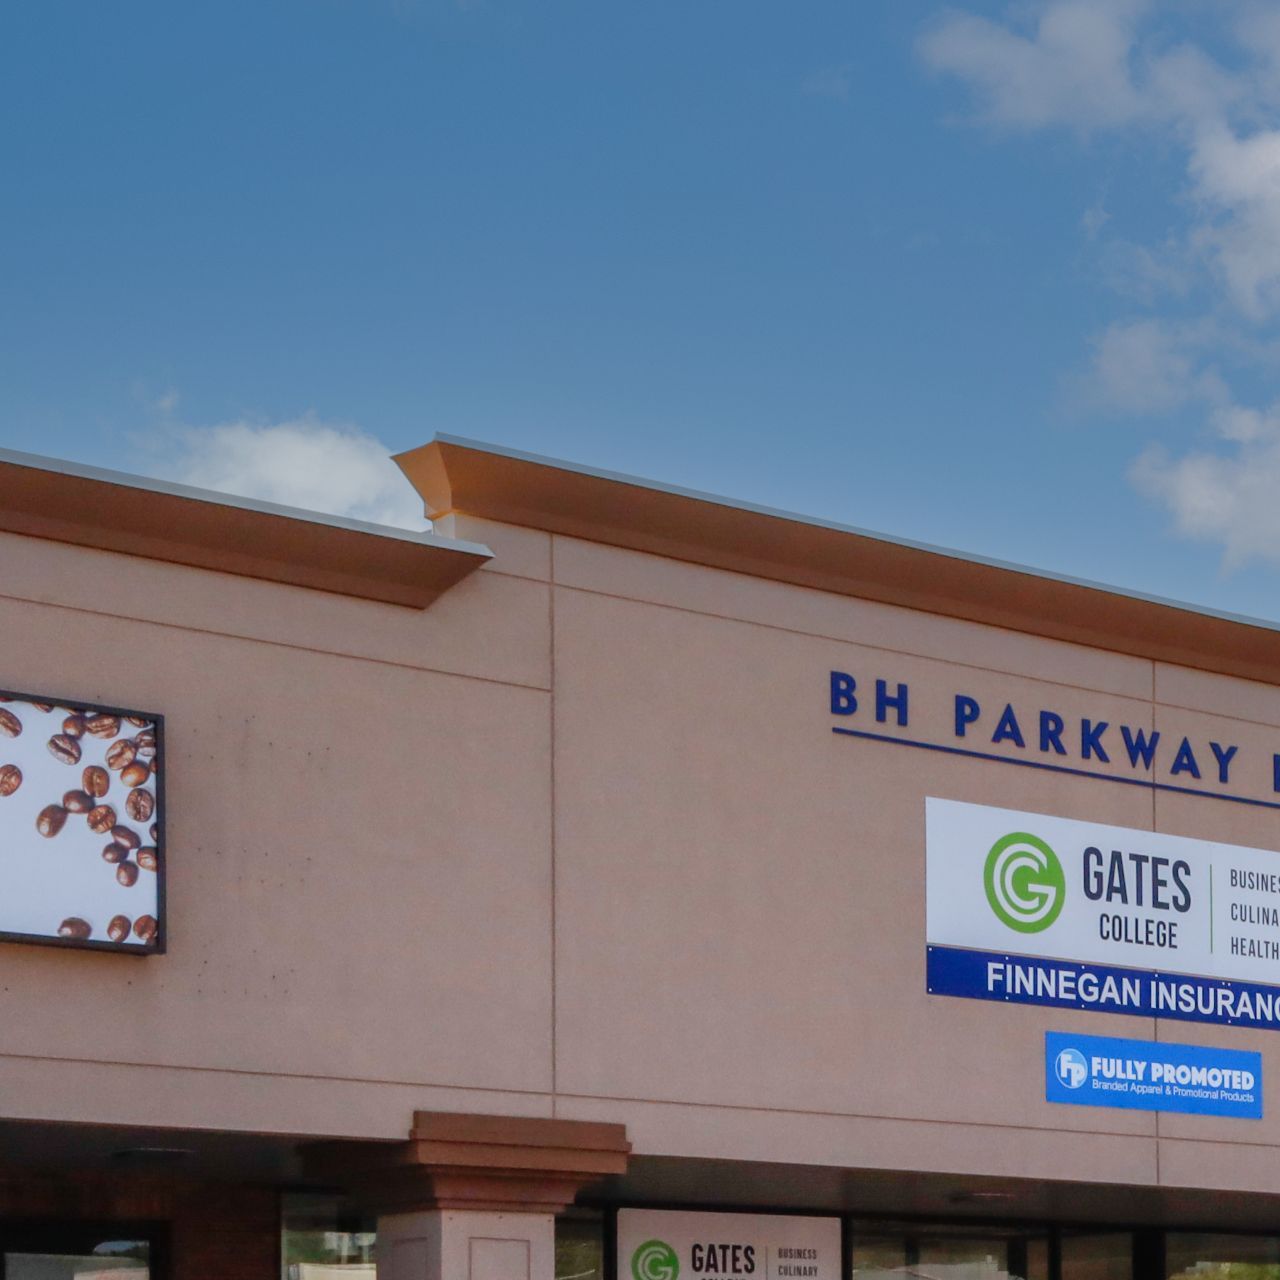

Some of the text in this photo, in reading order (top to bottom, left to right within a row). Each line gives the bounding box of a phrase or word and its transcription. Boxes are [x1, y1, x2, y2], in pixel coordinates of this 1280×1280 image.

[830, 671, 909, 726] BH
[953, 695, 1238, 784] PARKWAY
[1082, 845, 1192, 913] GATES
[1099, 913, 1178, 949] COLLEGE
[986, 961, 1142, 1007] FINNEGAN
[1091, 1056, 1254, 1091] FULLY PROMOTED
[1092, 1079, 1254, 1103] Branded Apparel & Promotional Products
[691, 1243, 755, 1274] GATES
[778, 1248, 818, 1260] BUSINESS
[778, 1265, 818, 1277] CULINARY
